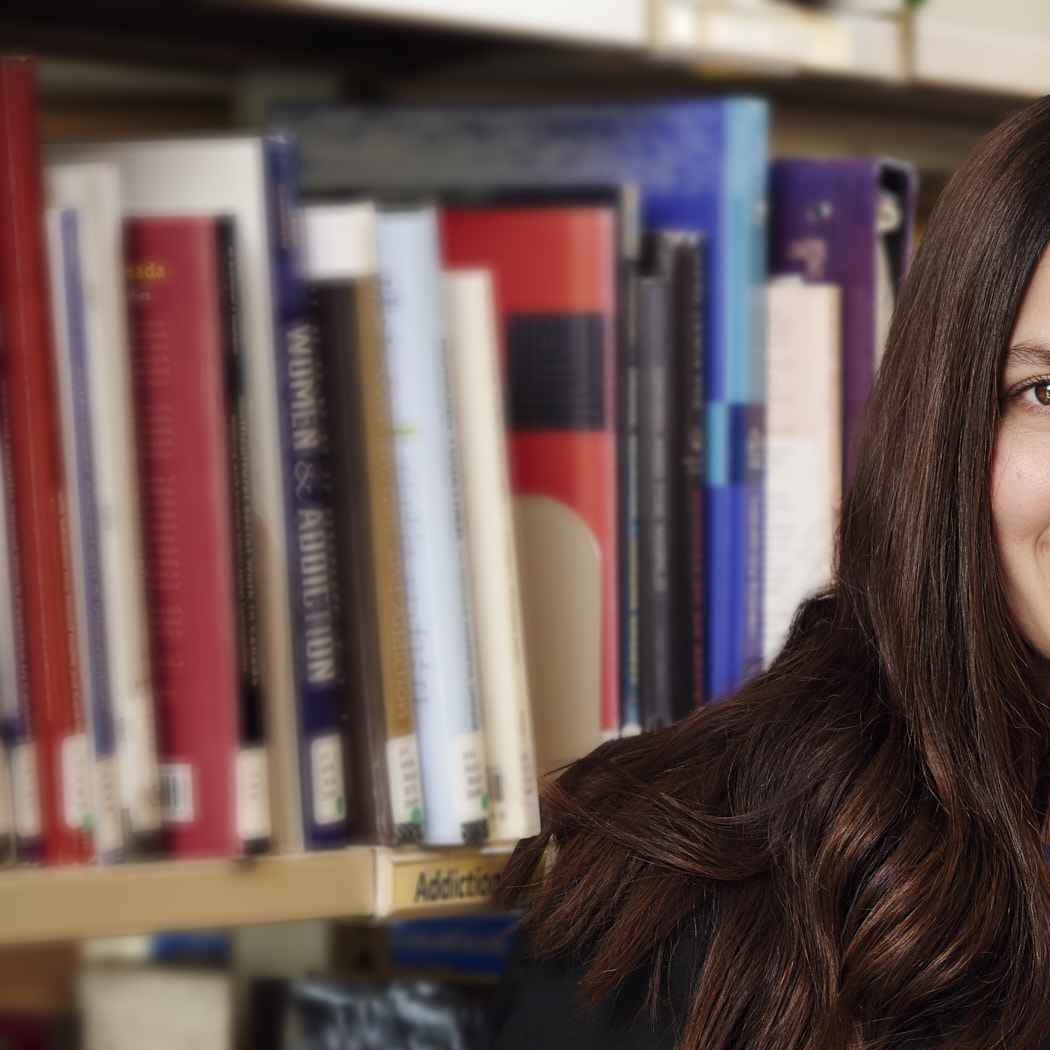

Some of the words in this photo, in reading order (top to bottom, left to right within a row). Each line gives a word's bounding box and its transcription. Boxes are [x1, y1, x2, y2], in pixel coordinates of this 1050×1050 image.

[286, 322, 320, 452] WOMEN
[294, 460, 314, 499] &
[246, 558, 256, 600] Work
[297, 507, 335, 685] ADDICTION
[249, 625, 260, 687] Canada
